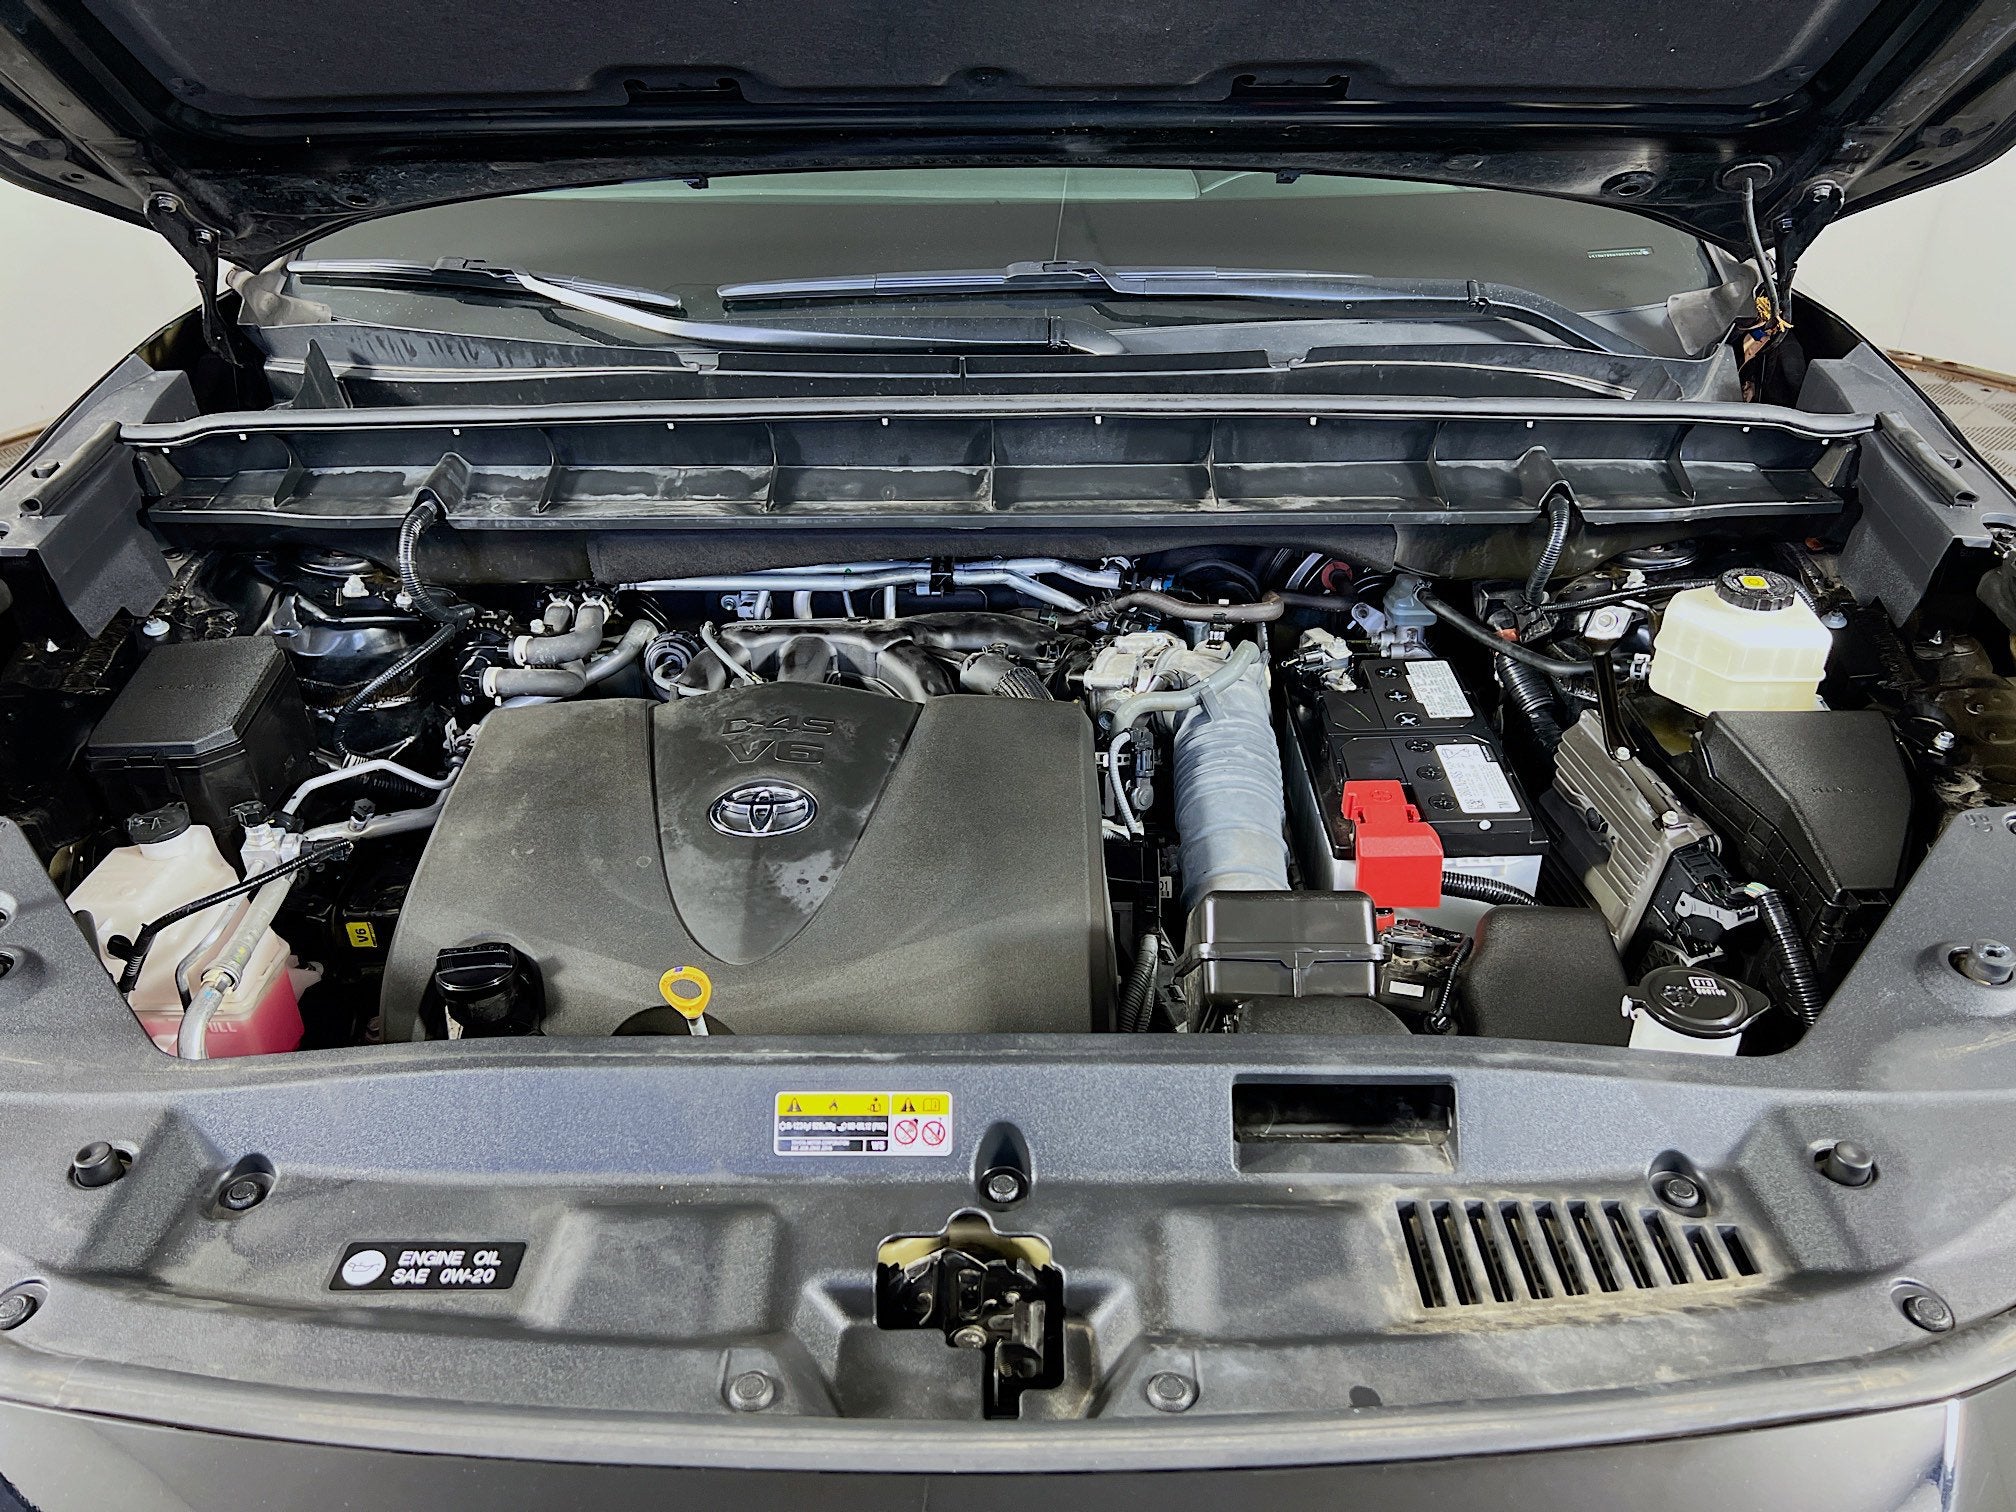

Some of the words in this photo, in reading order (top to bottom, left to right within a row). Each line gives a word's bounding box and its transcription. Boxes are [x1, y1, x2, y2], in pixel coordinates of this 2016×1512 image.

[722, 715, 836, 736] D-4S
[725, 739, 825, 765] V6
[354, 927, 369, 943] V6
[397, 1250, 465, 1267] ENGINE
[472, 1250, 502, 1267] OIL
[390, 1268, 431, 1285] SAE
[439, 1268, 497, 1285] 0W-20
